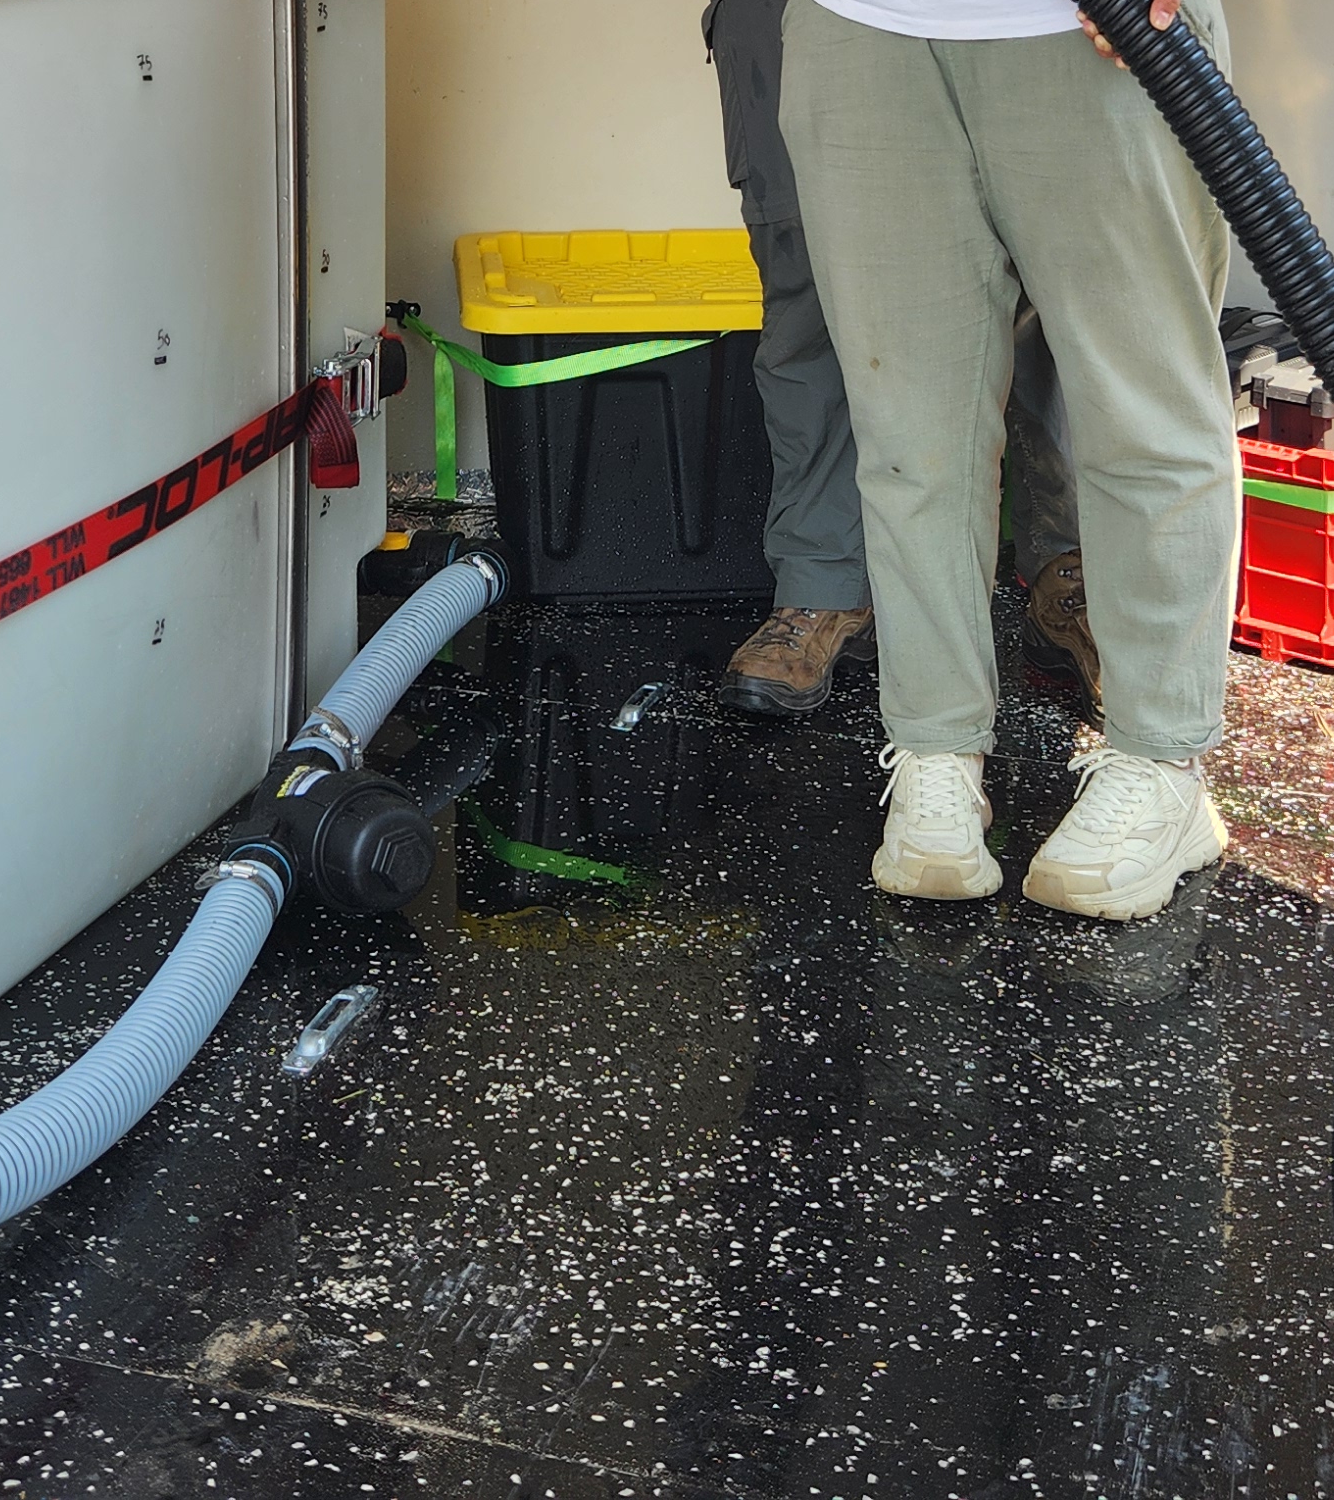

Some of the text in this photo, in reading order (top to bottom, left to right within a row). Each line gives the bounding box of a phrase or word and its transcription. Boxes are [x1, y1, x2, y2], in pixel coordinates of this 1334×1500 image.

[136, 54, 153, 71] 75
[157, 328, 171, 350] 50
[46, 523, 86, 559] WLL
[46, 554, 86, 590] WLL
